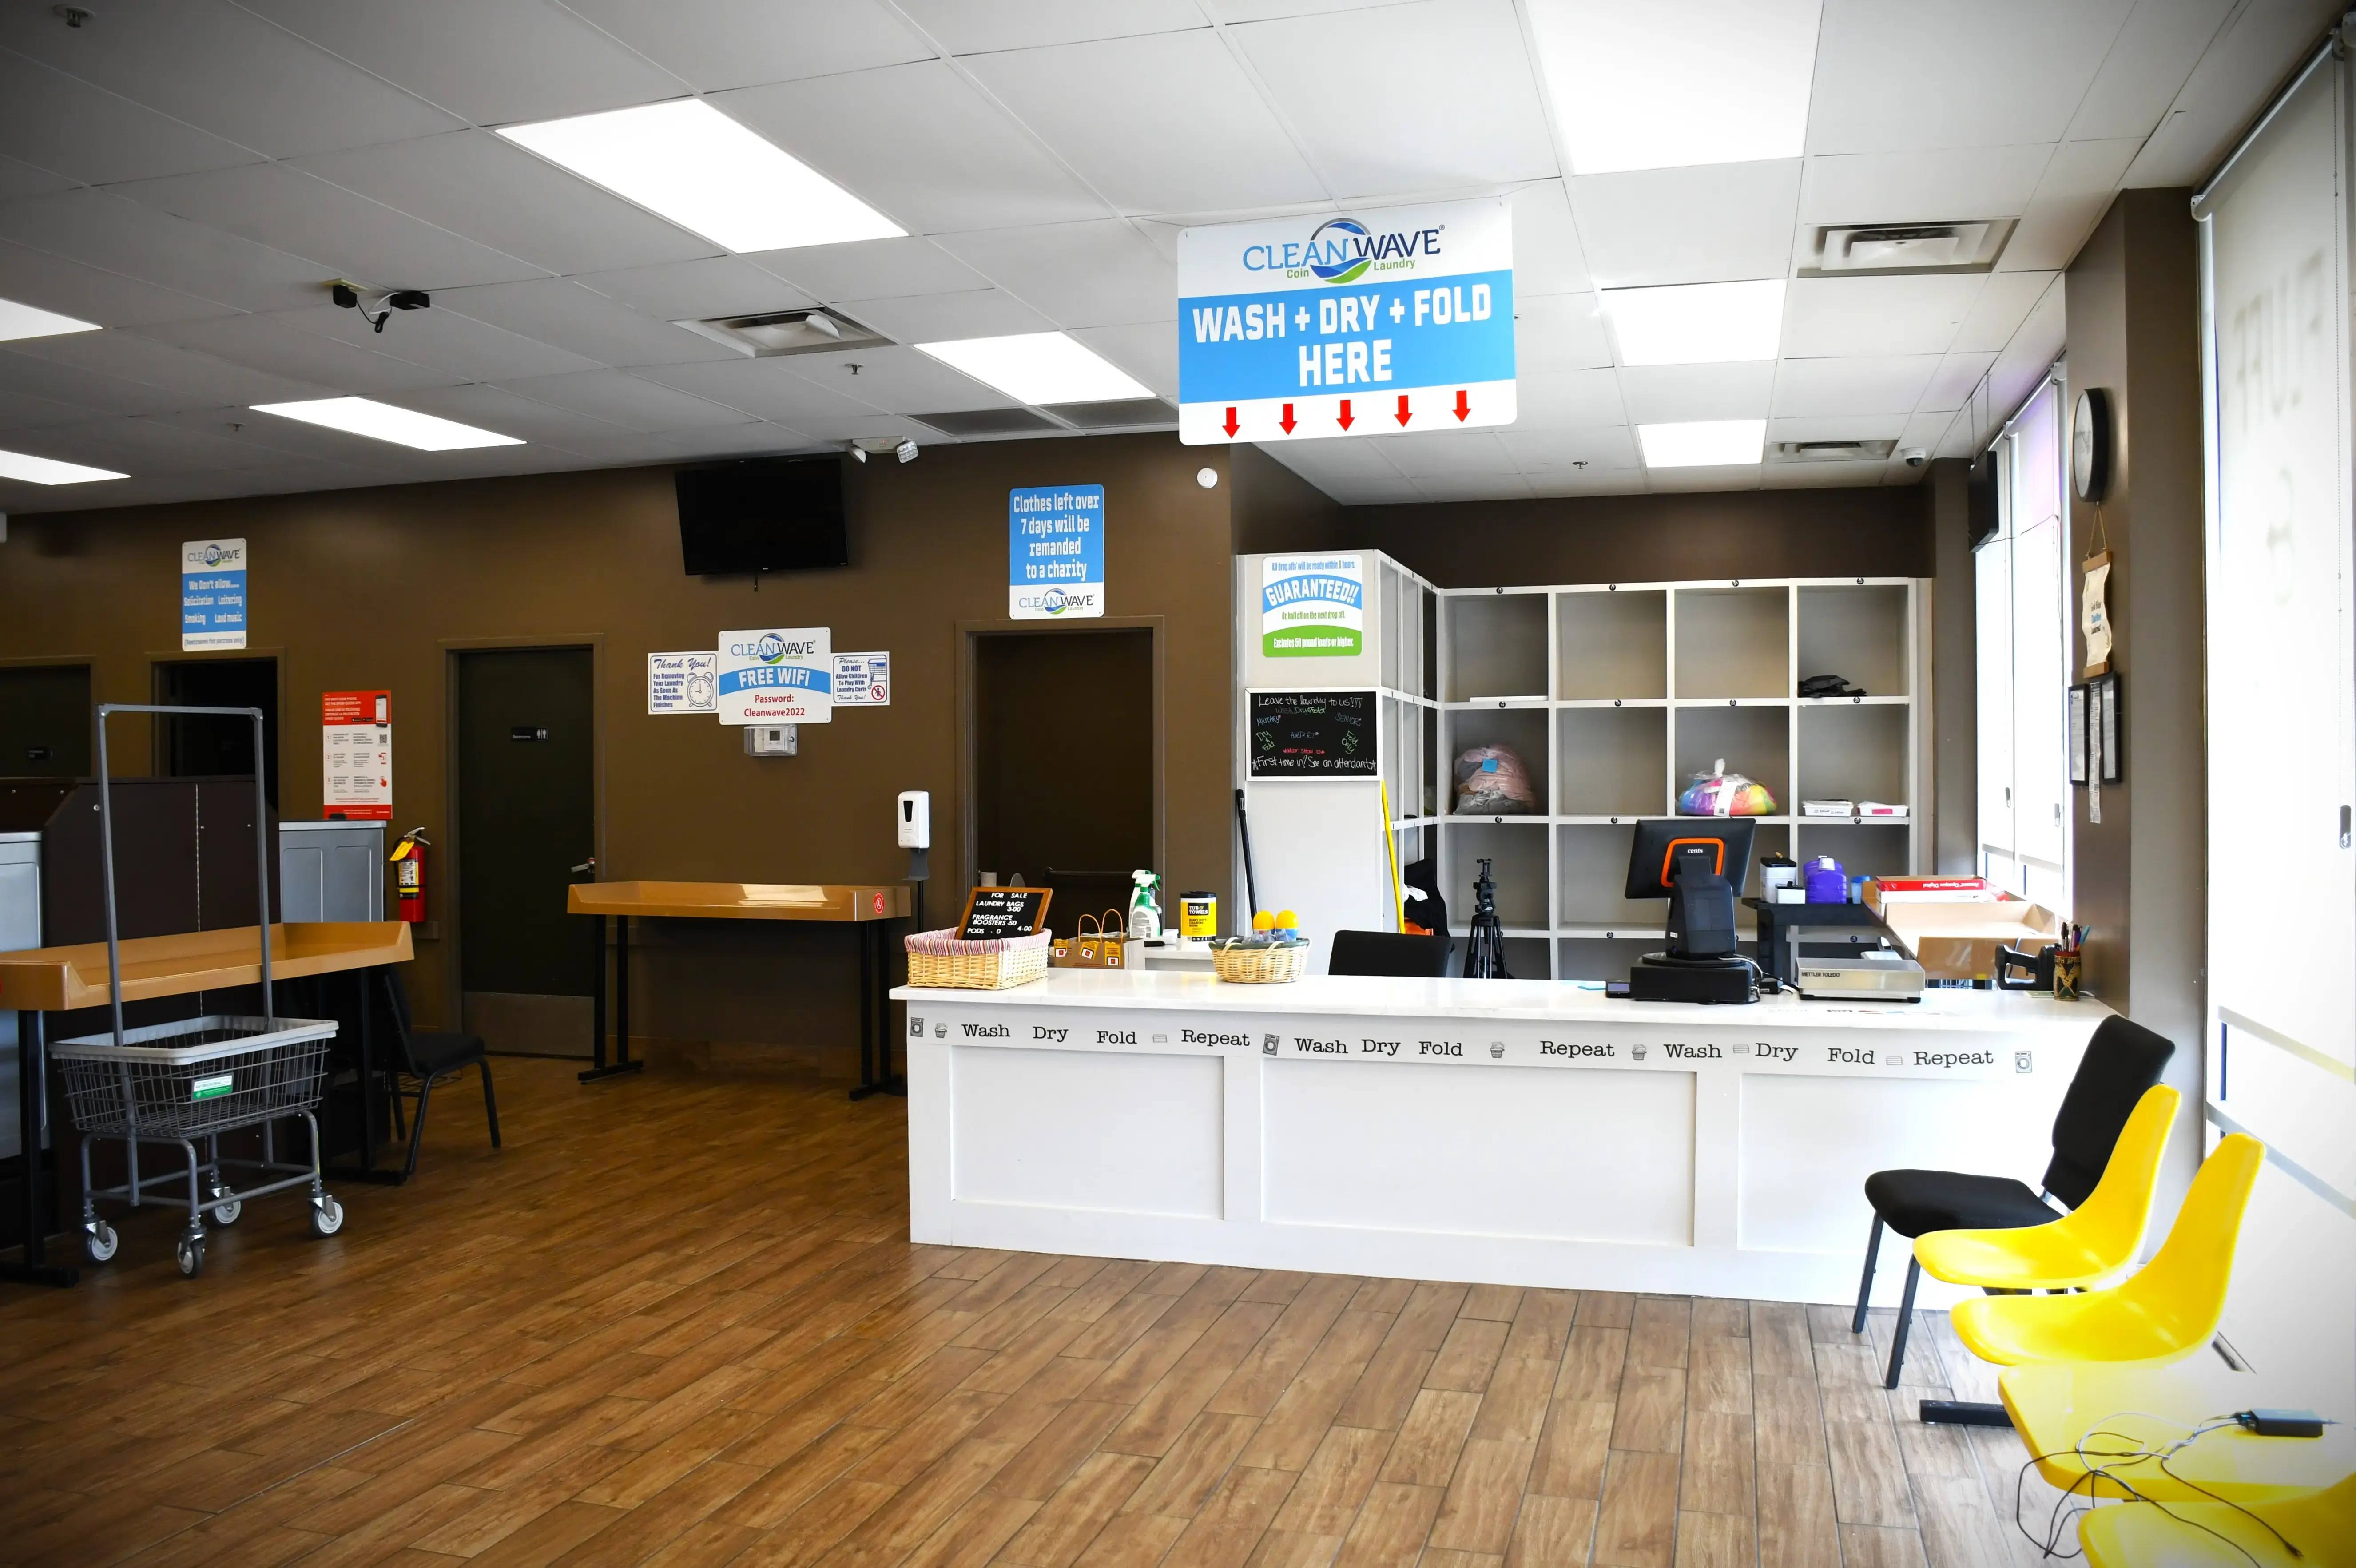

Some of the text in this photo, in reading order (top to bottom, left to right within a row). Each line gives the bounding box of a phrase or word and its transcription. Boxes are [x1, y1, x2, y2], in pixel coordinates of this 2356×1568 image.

[1287, 259, 1415, 278] Coin Laundry
[1192, 302, 1285, 343] WASH
[1320, 295, 1380, 335] DRY
[1414, 283, 1491, 326] FOLD
[1299, 339, 1392, 387] HERE
[1013, 492, 1099, 512] Clothes left over
[1021, 514, 1089, 539] 7 days will be
[1029, 537, 1081, 556] remanded
[1026, 558, 1087, 582] to a charity
[1279, 563, 1287, 571] drop
[1307, 561, 1311, 570] be
[1312, 561, 1324, 570] ready
[1325, 560, 1338, 569] within
[1266, 579, 1359, 606] GUARANTEED!!
[185, 611, 242, 625] Smoking Loud music
[1328, 611, 1338, 619] drop
[1274, 638, 1294, 648] Excludes
[1295, 638, 1301, 647] 50
[1302, 637, 1317, 648] pound
[1318, 637, 1331, 647] loads
[654, 657, 711, 671] Thank You!
[739, 668, 810, 688] FREE WIFI
[755, 694, 794, 703] Password:
[1259, 695, 1283, 707] Leave
[1285, 696, 1297, 705] the
[744, 708, 805, 717] Cleanwave2022
[1308, 756, 1319, 768] See
[961, 1024, 1994, 1066] Wash Dry Fold Repeat Wash Dry Fold Repeat Wash Dry Fold Repeat
